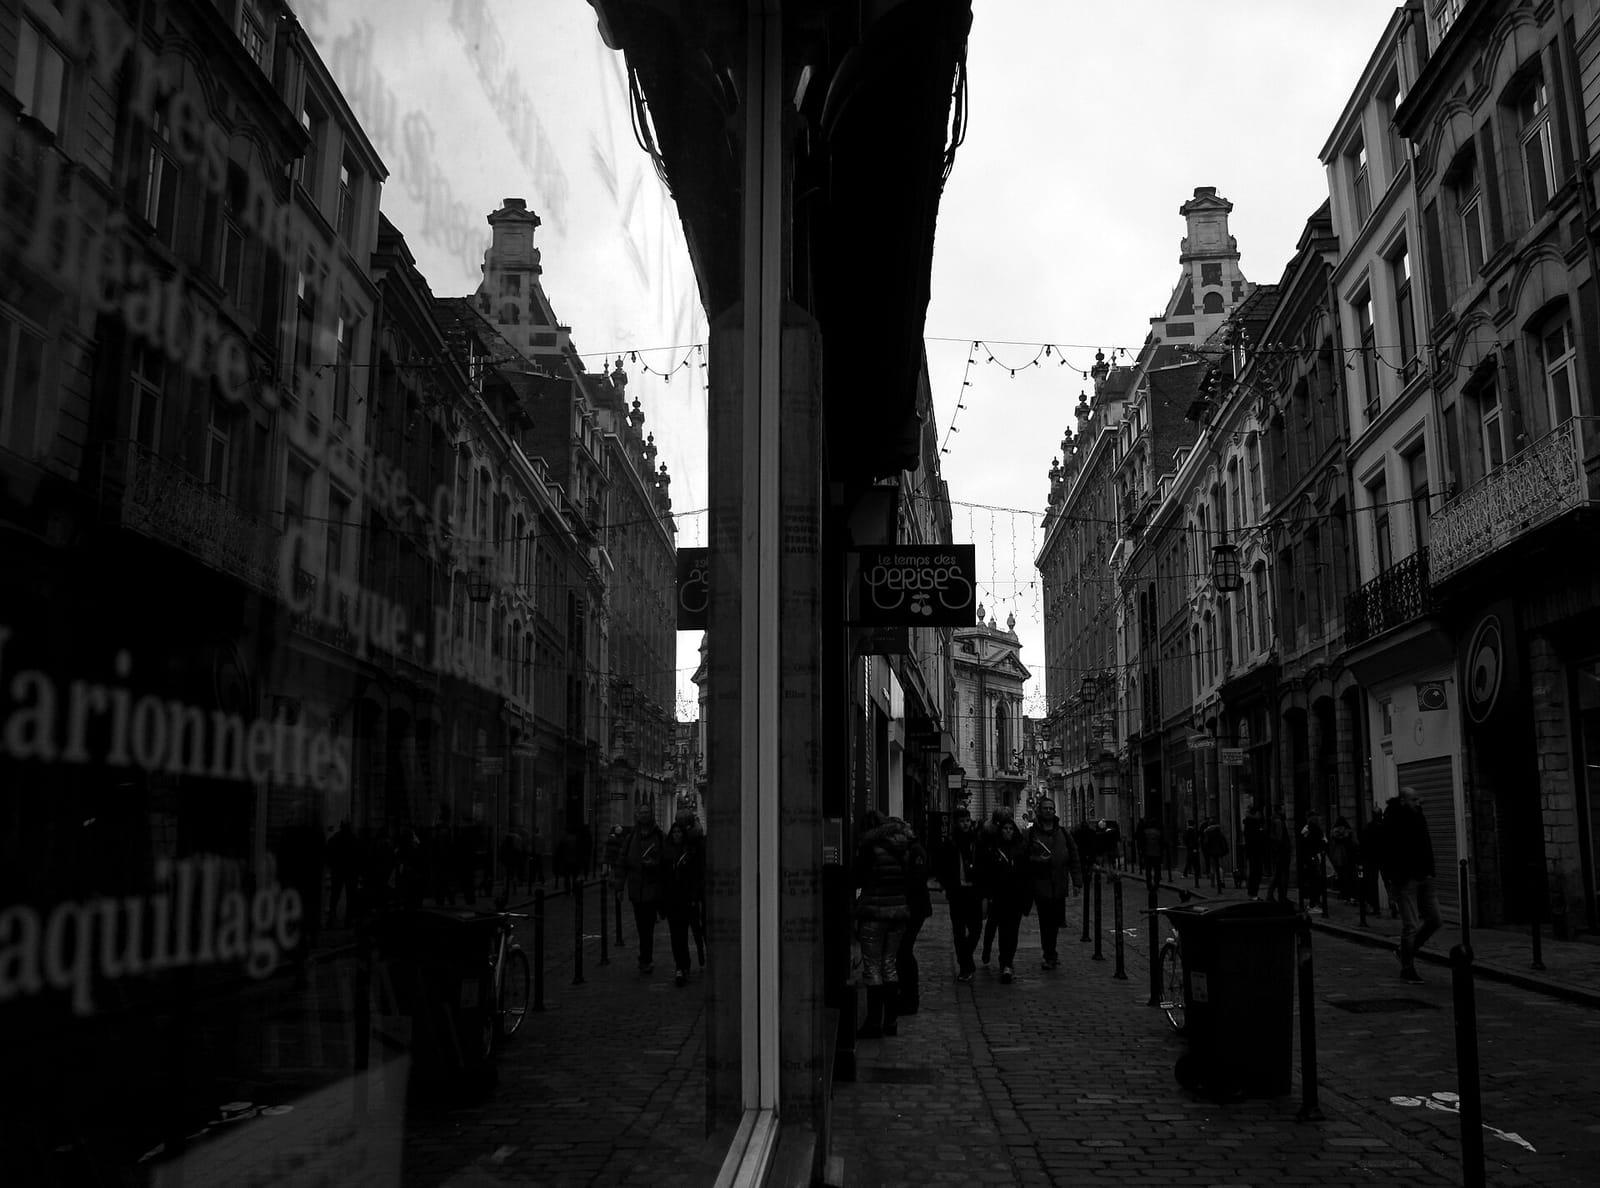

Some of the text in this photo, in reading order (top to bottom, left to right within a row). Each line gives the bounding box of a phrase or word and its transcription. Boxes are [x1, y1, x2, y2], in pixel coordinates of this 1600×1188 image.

[894, 553, 930, 568] temps
[933, 553, 957, 566] des
[0, 624, 352, 792] arionnettes
